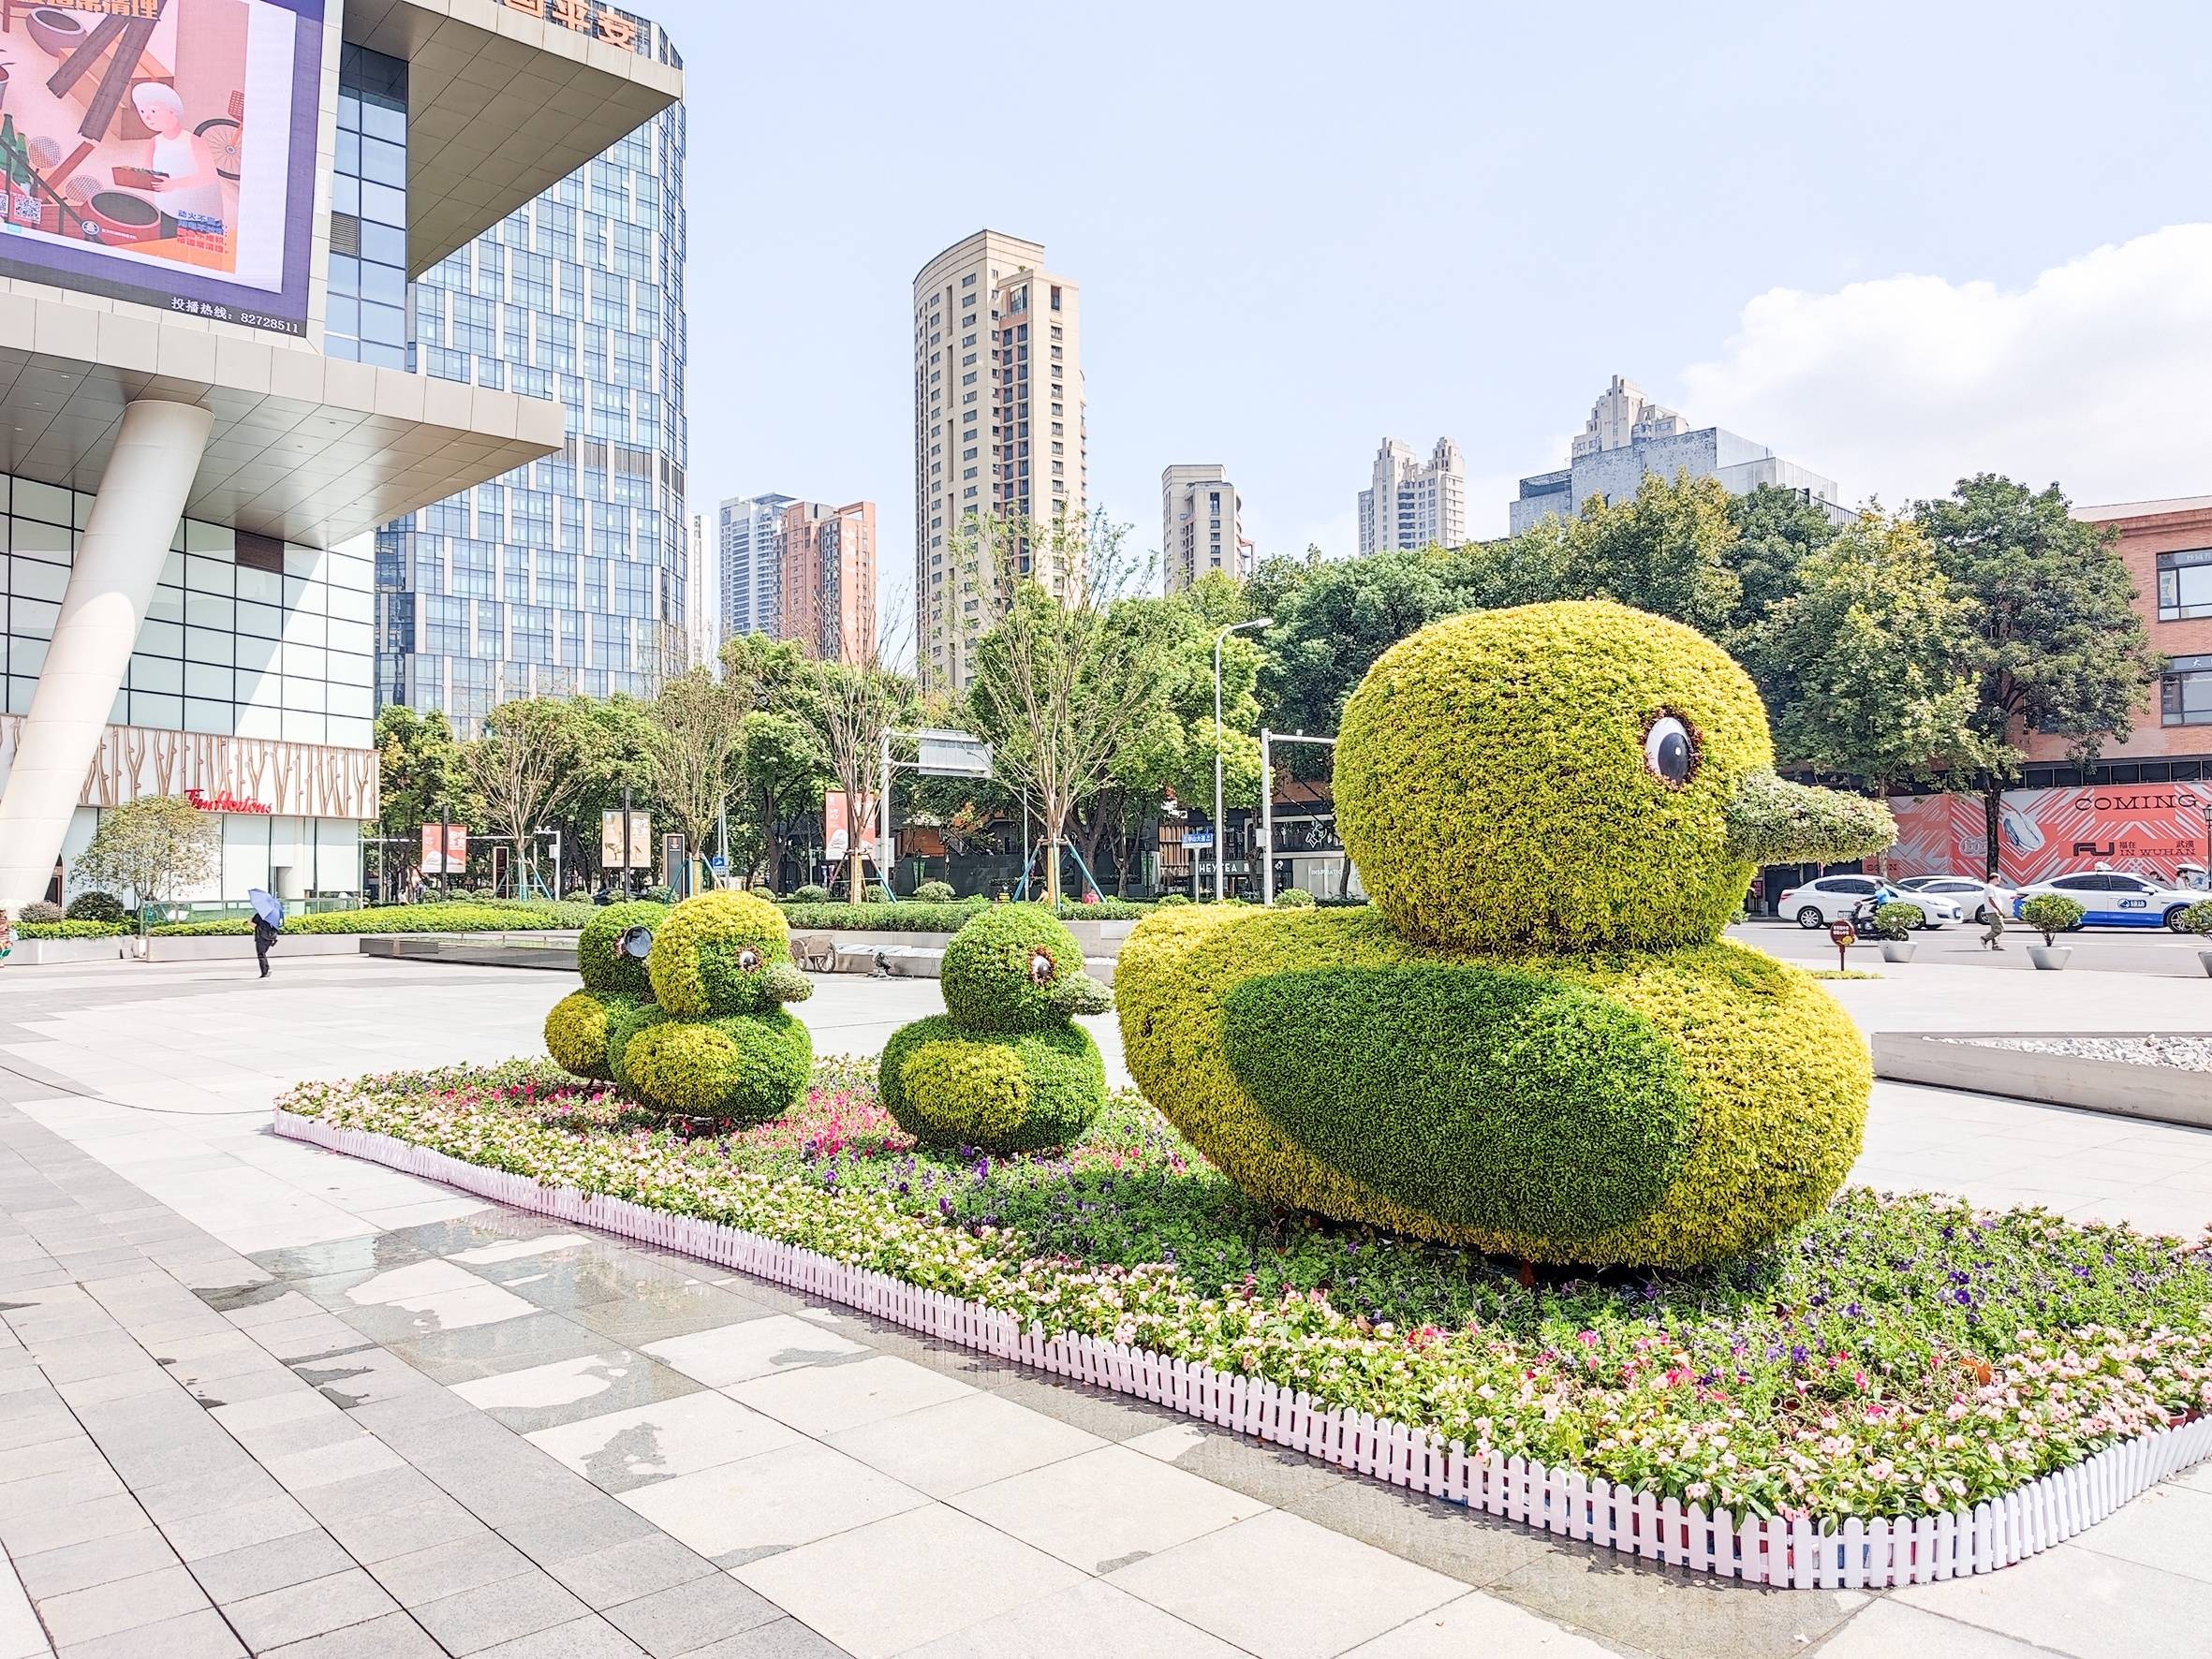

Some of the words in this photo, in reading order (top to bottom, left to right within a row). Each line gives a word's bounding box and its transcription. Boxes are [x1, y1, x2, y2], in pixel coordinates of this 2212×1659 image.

[241, 313, 298, 333] 82728511
[184, 789, 213, 811] Tim
[214, 790, 273, 814] Hortons
[2074, 794, 2198, 812] COMING
[1199, 863, 1237, 873] HEYEA
[1866, 863, 1897, 872] SN
